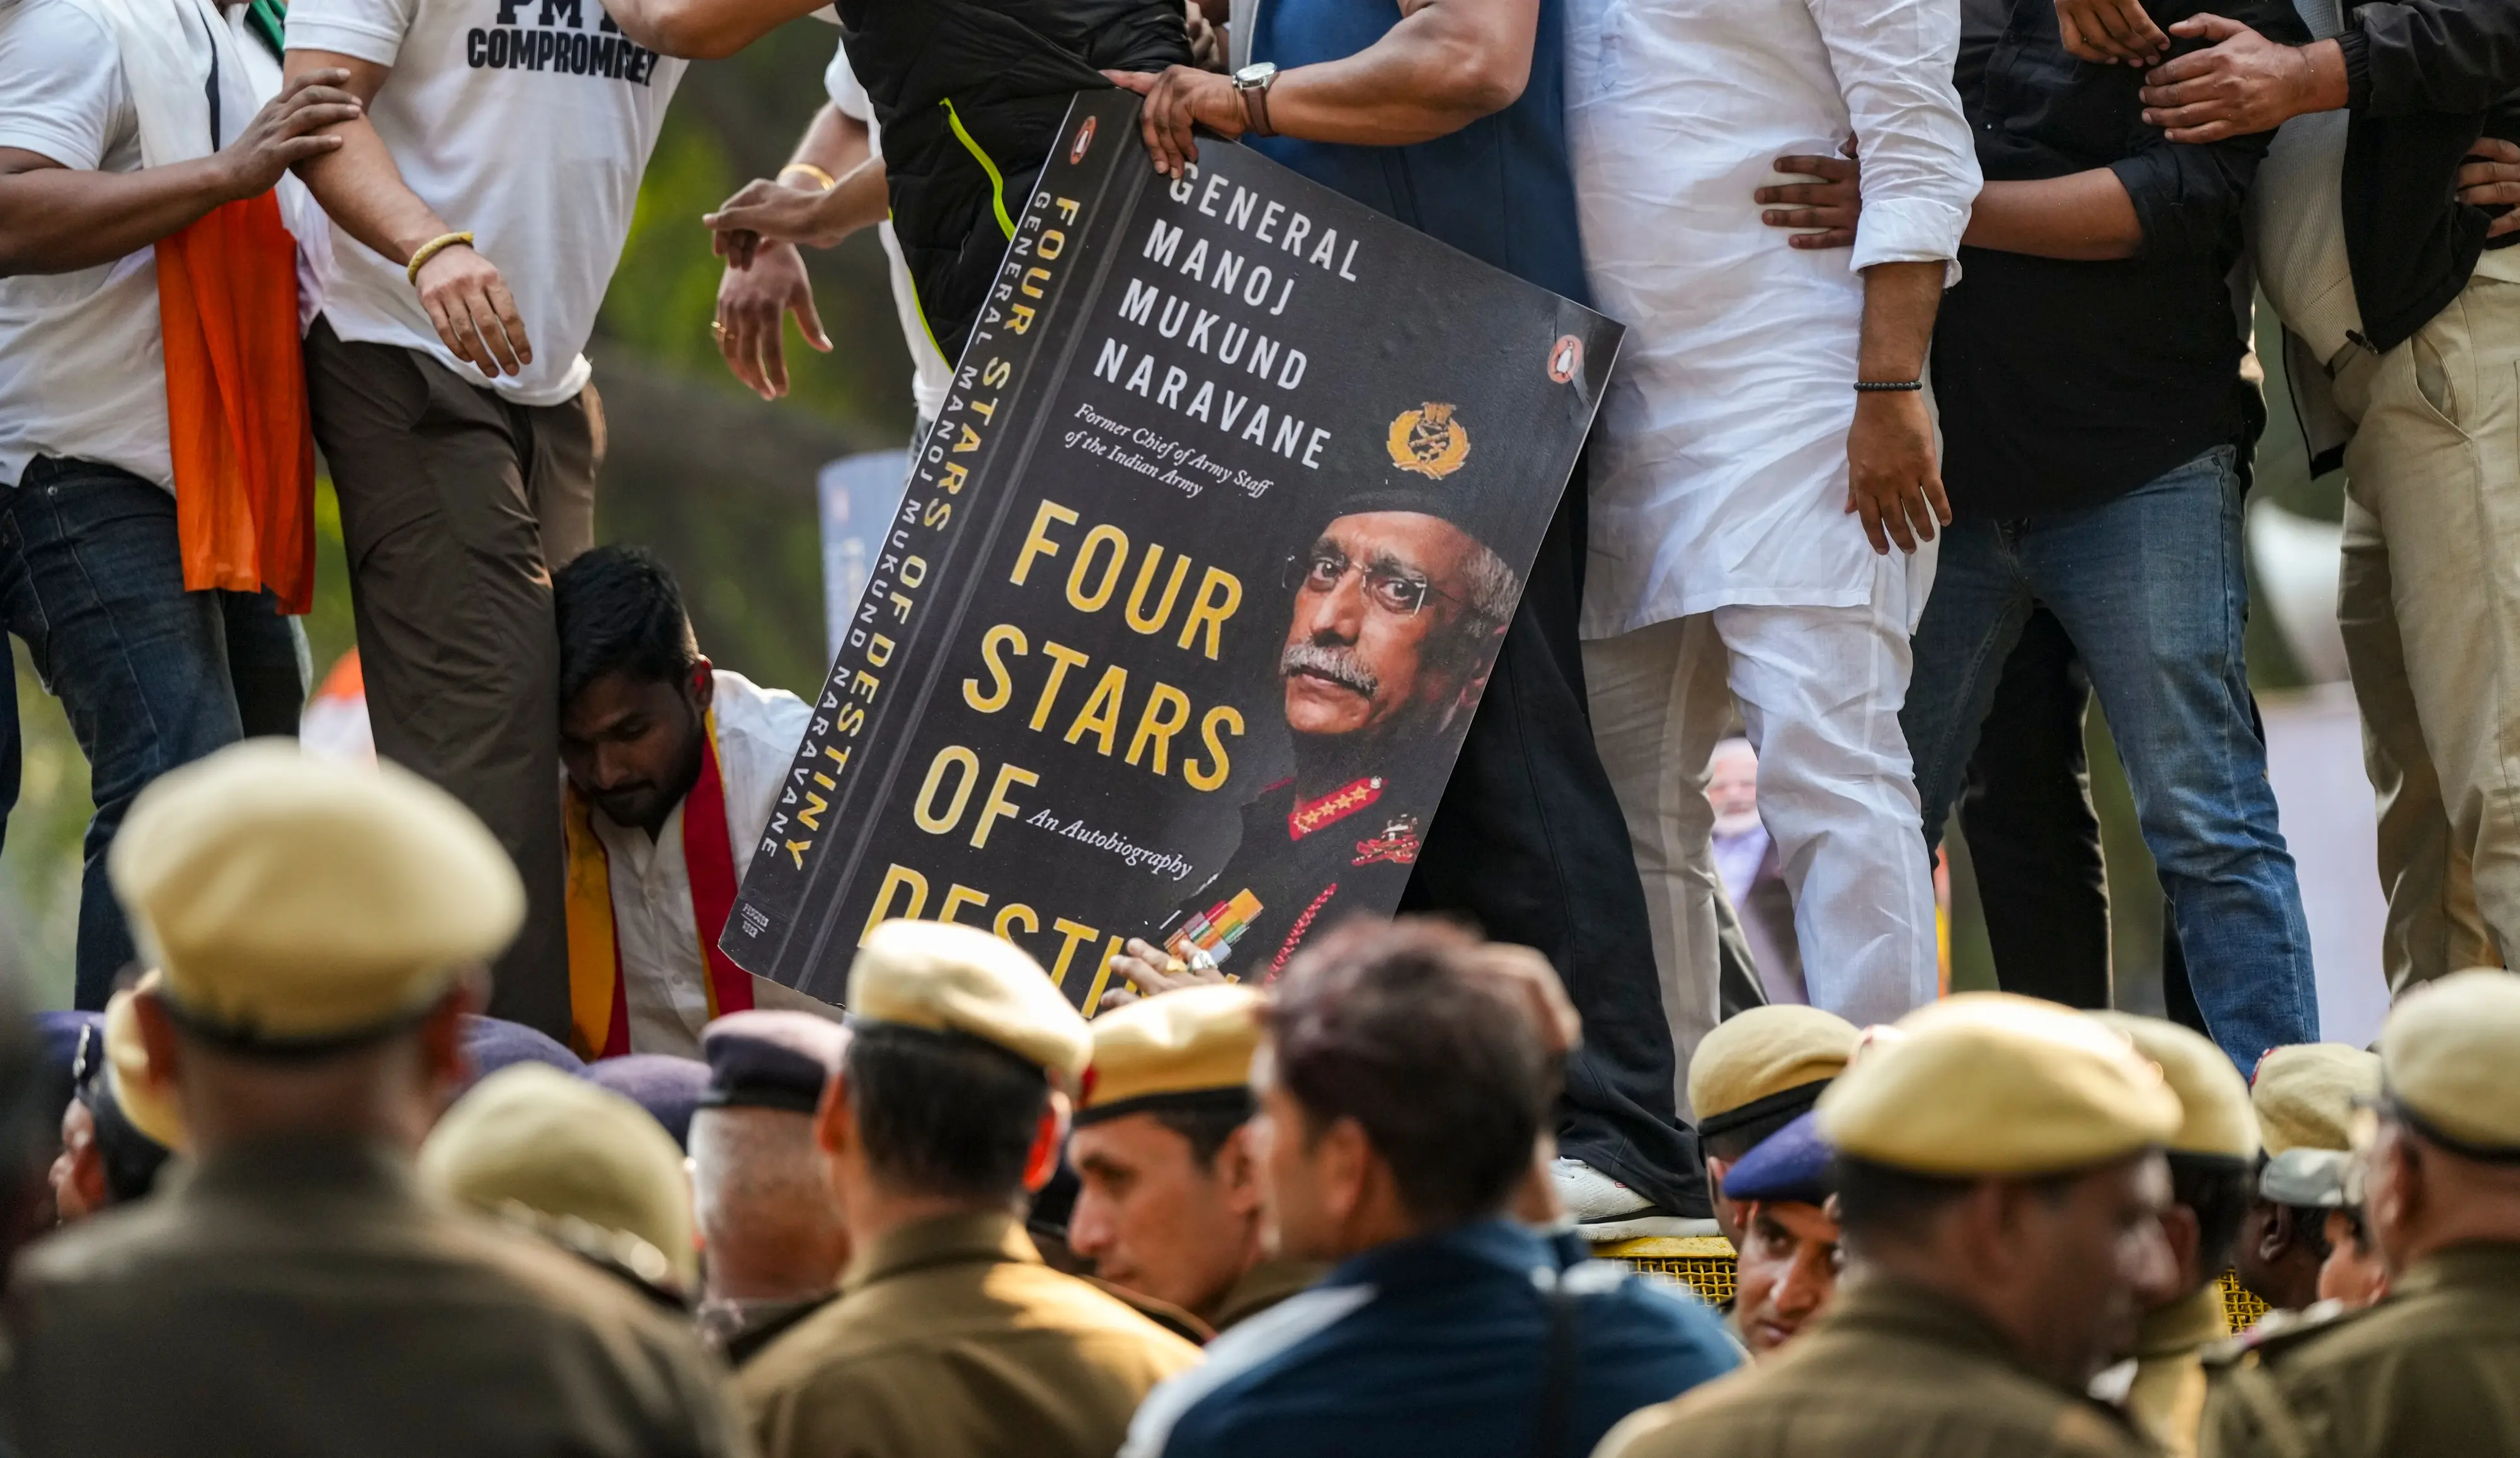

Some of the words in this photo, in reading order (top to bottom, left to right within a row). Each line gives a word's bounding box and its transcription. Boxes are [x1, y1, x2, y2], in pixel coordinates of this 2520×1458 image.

[975, 191, 1051, 345] GENERAL
[1004, 196, 1081, 335] FOUR
[1143, 219, 1295, 316] MANOJ
[1169, 162, 1359, 282] GENERAL
[1118, 278, 1307, 390] MUKUND
[920, 366, 978, 482] MANOJ
[924, 356, 1011, 532] STARS
[1065, 431, 1086, 449] of
[1083, 435, 1108, 457] the
[1108, 444, 1160, 477] Indian
[1158, 470, 1203, 498] Army
[1074, 403, 1131, 436] Former
[1132, 427, 1179, 460] Chief
[1173, 443, 1196, 465] of
[1188, 454, 1233, 484] Army
[1233, 469, 1274, 498] Staff
[1093, 338, 1331, 469] NARAVANE
[850, 499, 921, 648] MUKUND
[890, 555, 927, 625] OF
[1009, 499, 1243, 661] FOUR
[761, 666, 852, 857] NARAVANE
[785, 632, 896, 871] DESTINY
[962, 624, 1246, 792] STARS
[913, 744, 1040, 850] OF
[1026, 808, 1060, 832] An
[1058, 819, 1193, 881] Autobiography
